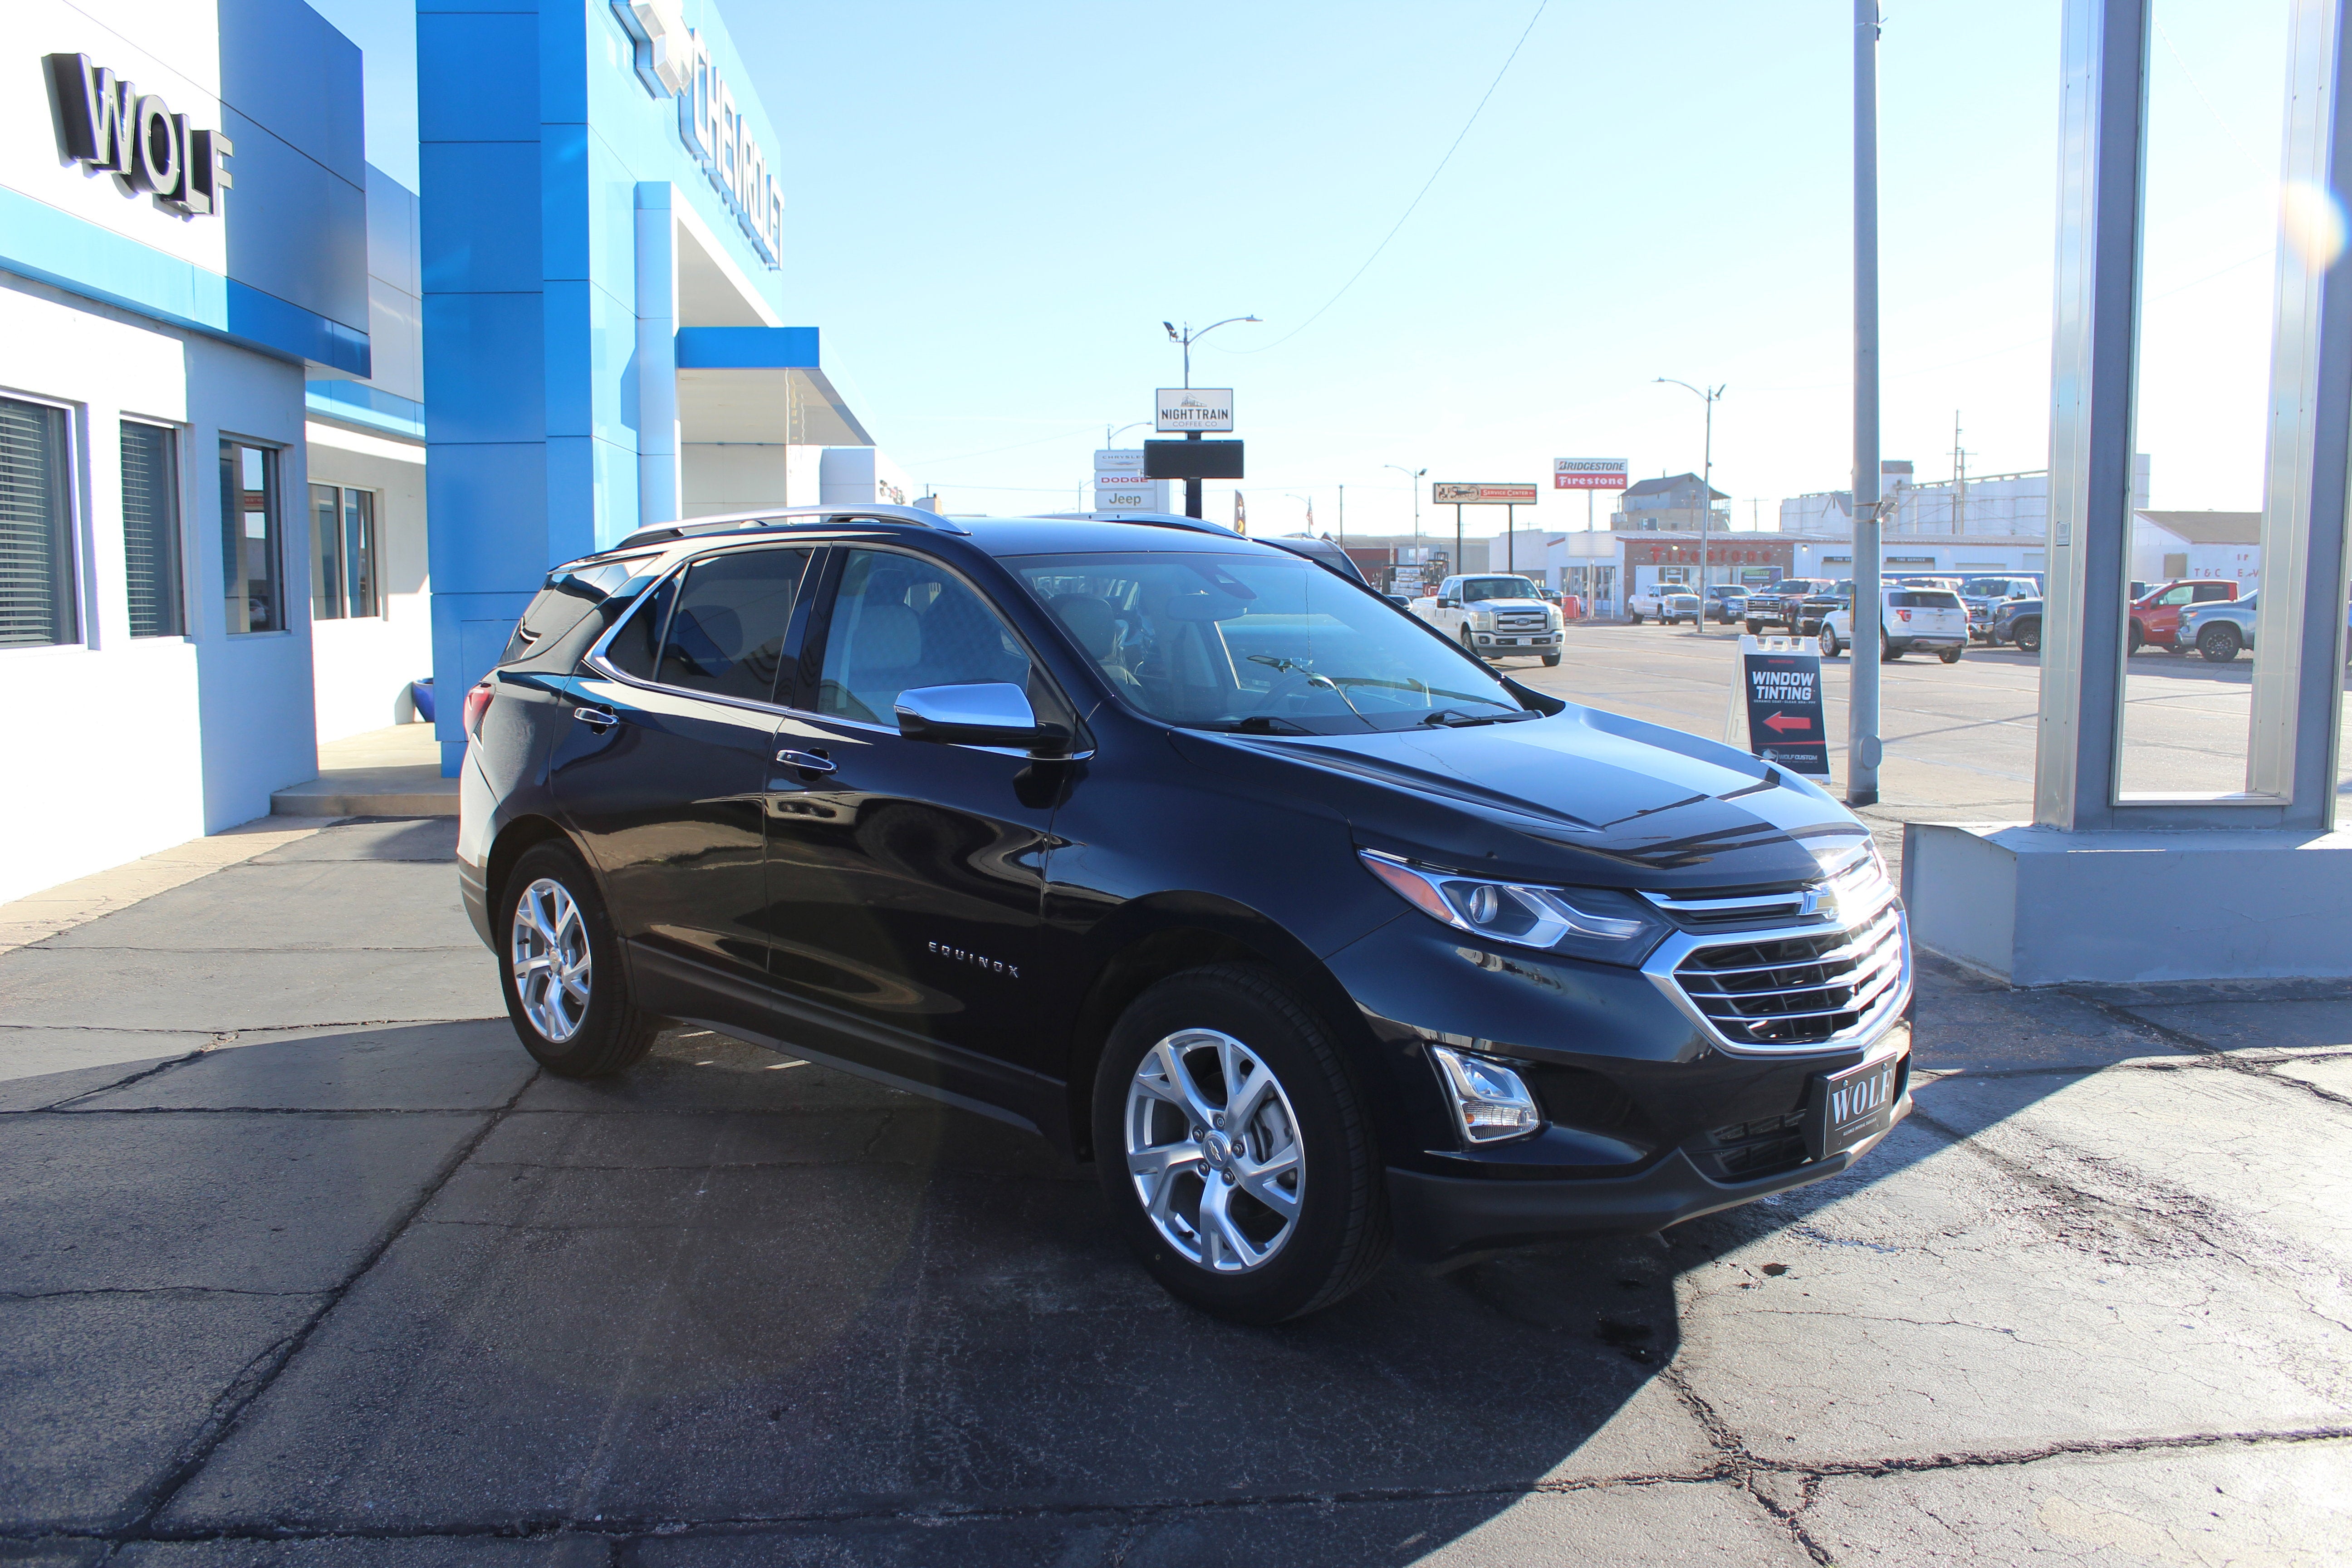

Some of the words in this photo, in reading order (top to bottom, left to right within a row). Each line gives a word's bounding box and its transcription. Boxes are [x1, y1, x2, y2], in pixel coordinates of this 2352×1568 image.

[44, 52, 234, 220] WOLF
[677, 26, 784, 272] CHEVROLET
[1161, 409, 1194, 420] NIGHT
[1196, 409, 1228, 420] TRAIN
[1558, 461, 1625, 471] BRIDGESTONE
[1559, 476, 1624, 486] Firestone
[1109, 493, 1141, 506] Jeep
[1650, 546, 1772, 563] Firestone
[1752, 671, 1815, 686] WINDOW
[1756, 686, 1812, 700] TINTING
[929, 941, 1018, 978] EQUINOX
[1832, 1068, 1892, 1124] WOLF
